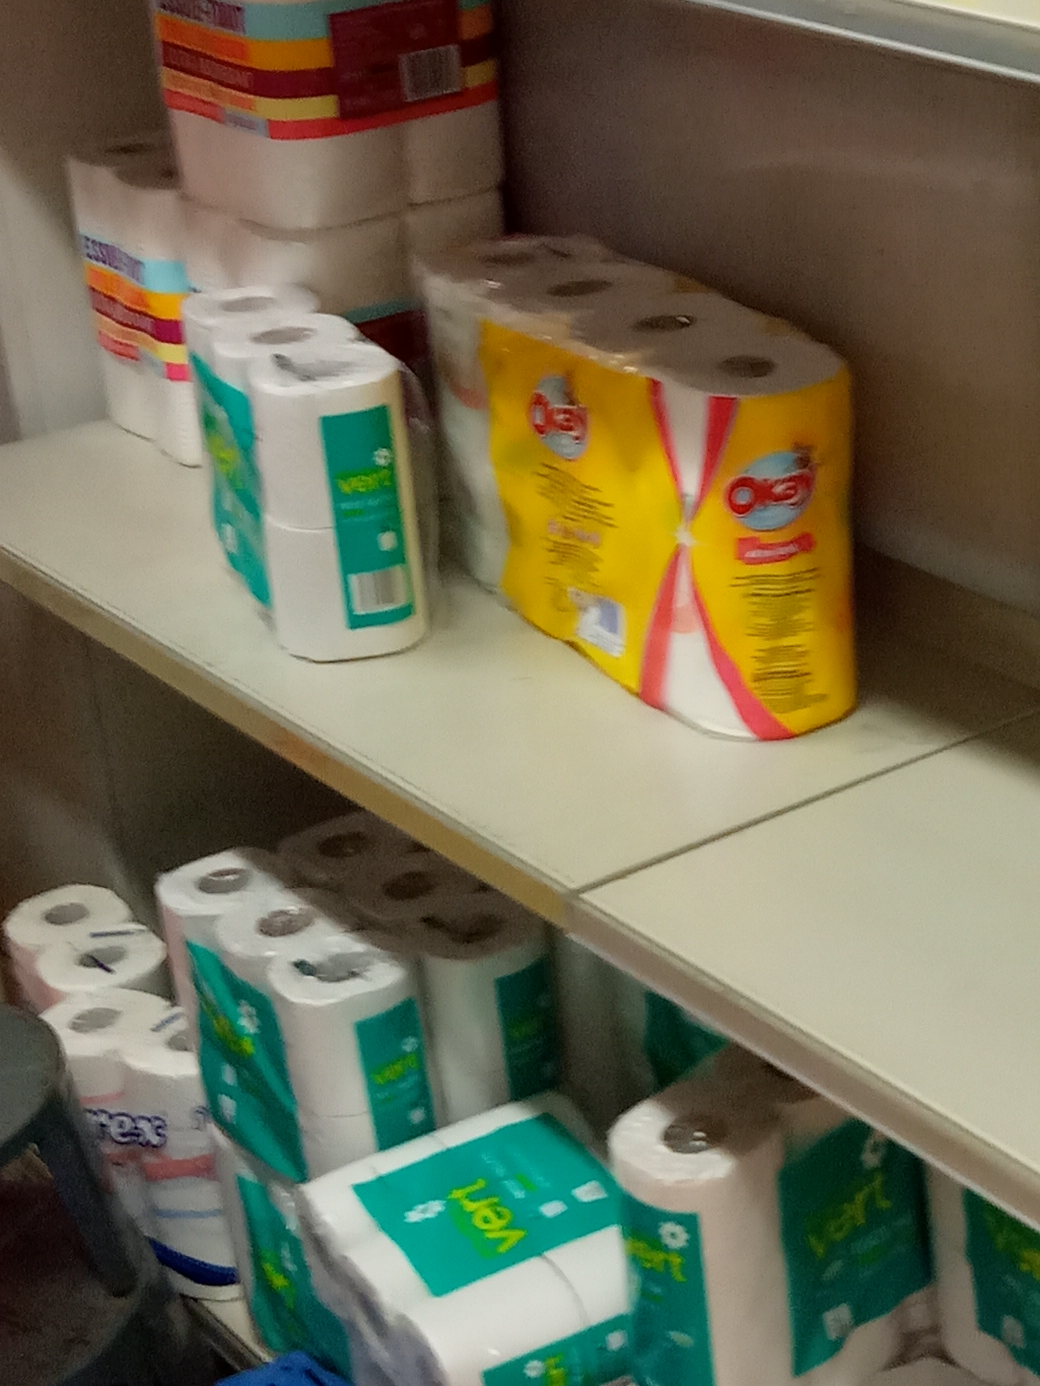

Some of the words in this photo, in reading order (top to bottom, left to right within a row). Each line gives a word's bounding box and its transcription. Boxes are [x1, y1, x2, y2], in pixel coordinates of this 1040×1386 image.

[727, 469, 816, 517] Okay
[447, 1177, 528, 1254] vert
[808, 1172, 892, 1260] vert
